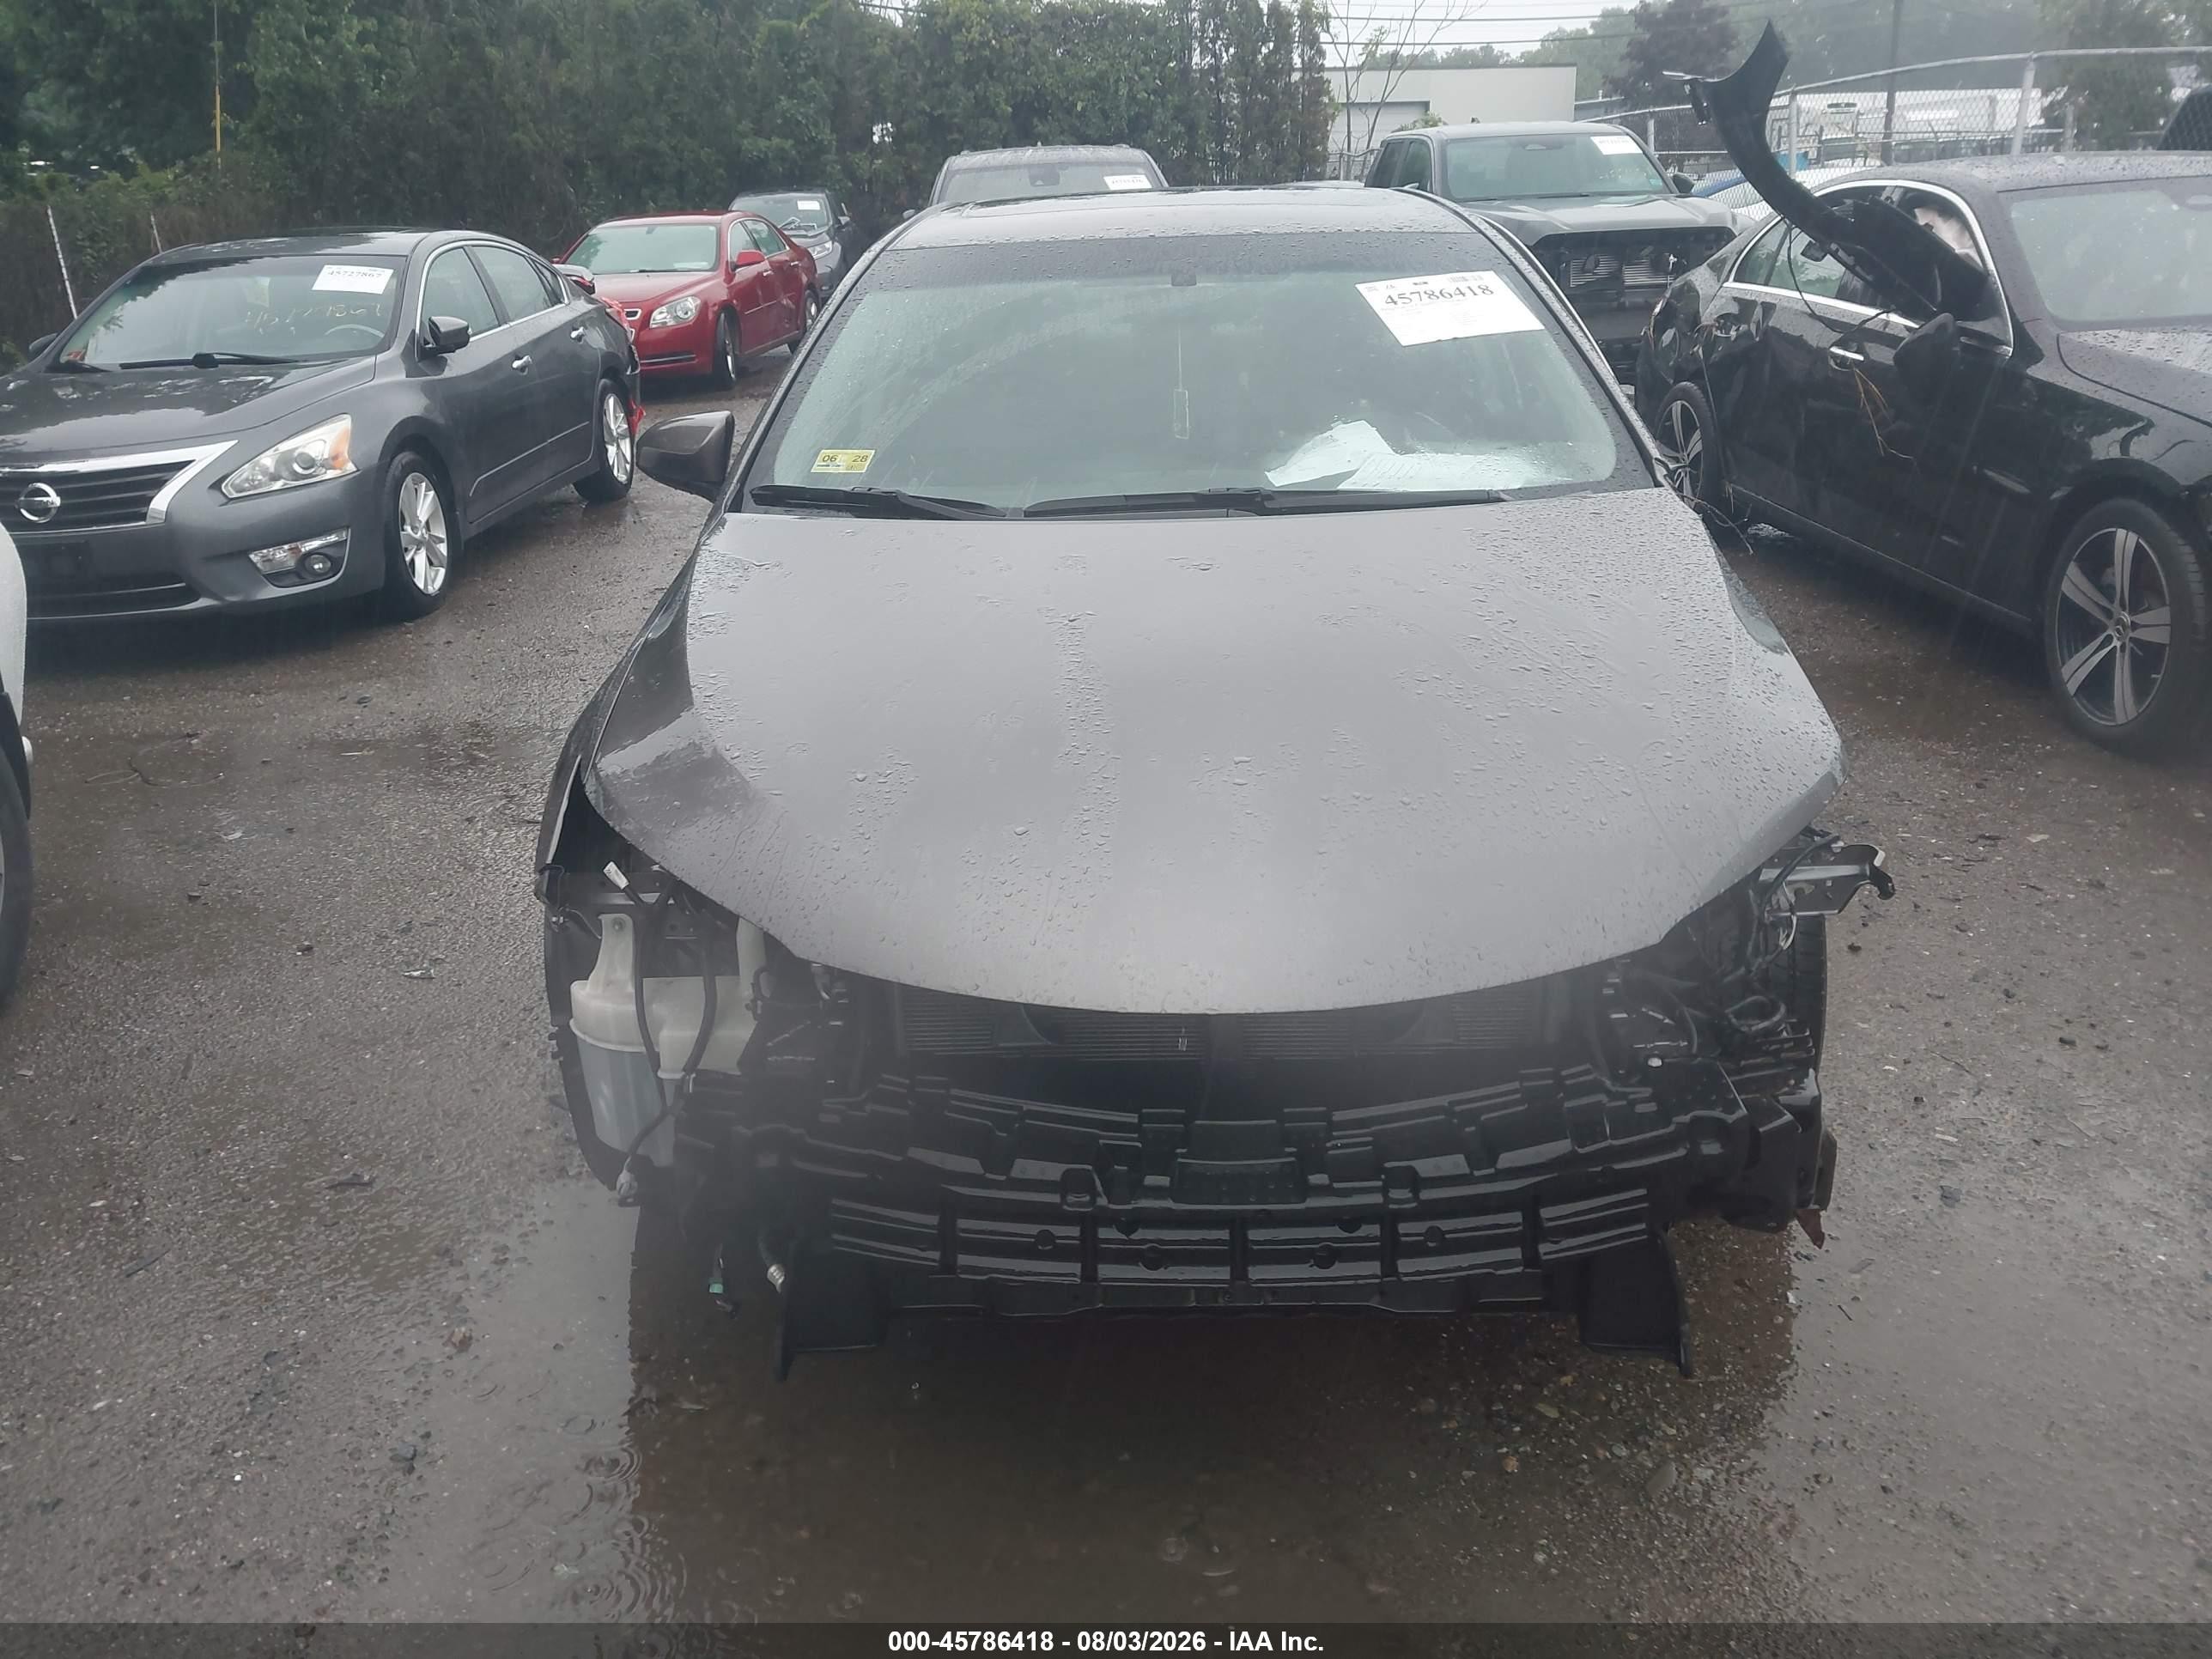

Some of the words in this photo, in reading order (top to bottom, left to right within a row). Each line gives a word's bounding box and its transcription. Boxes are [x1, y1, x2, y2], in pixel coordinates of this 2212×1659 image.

[1384, 284, 1494, 306] 45786418
[822, 454, 838, 463] 06
[852, 454, 868, 463] 28
